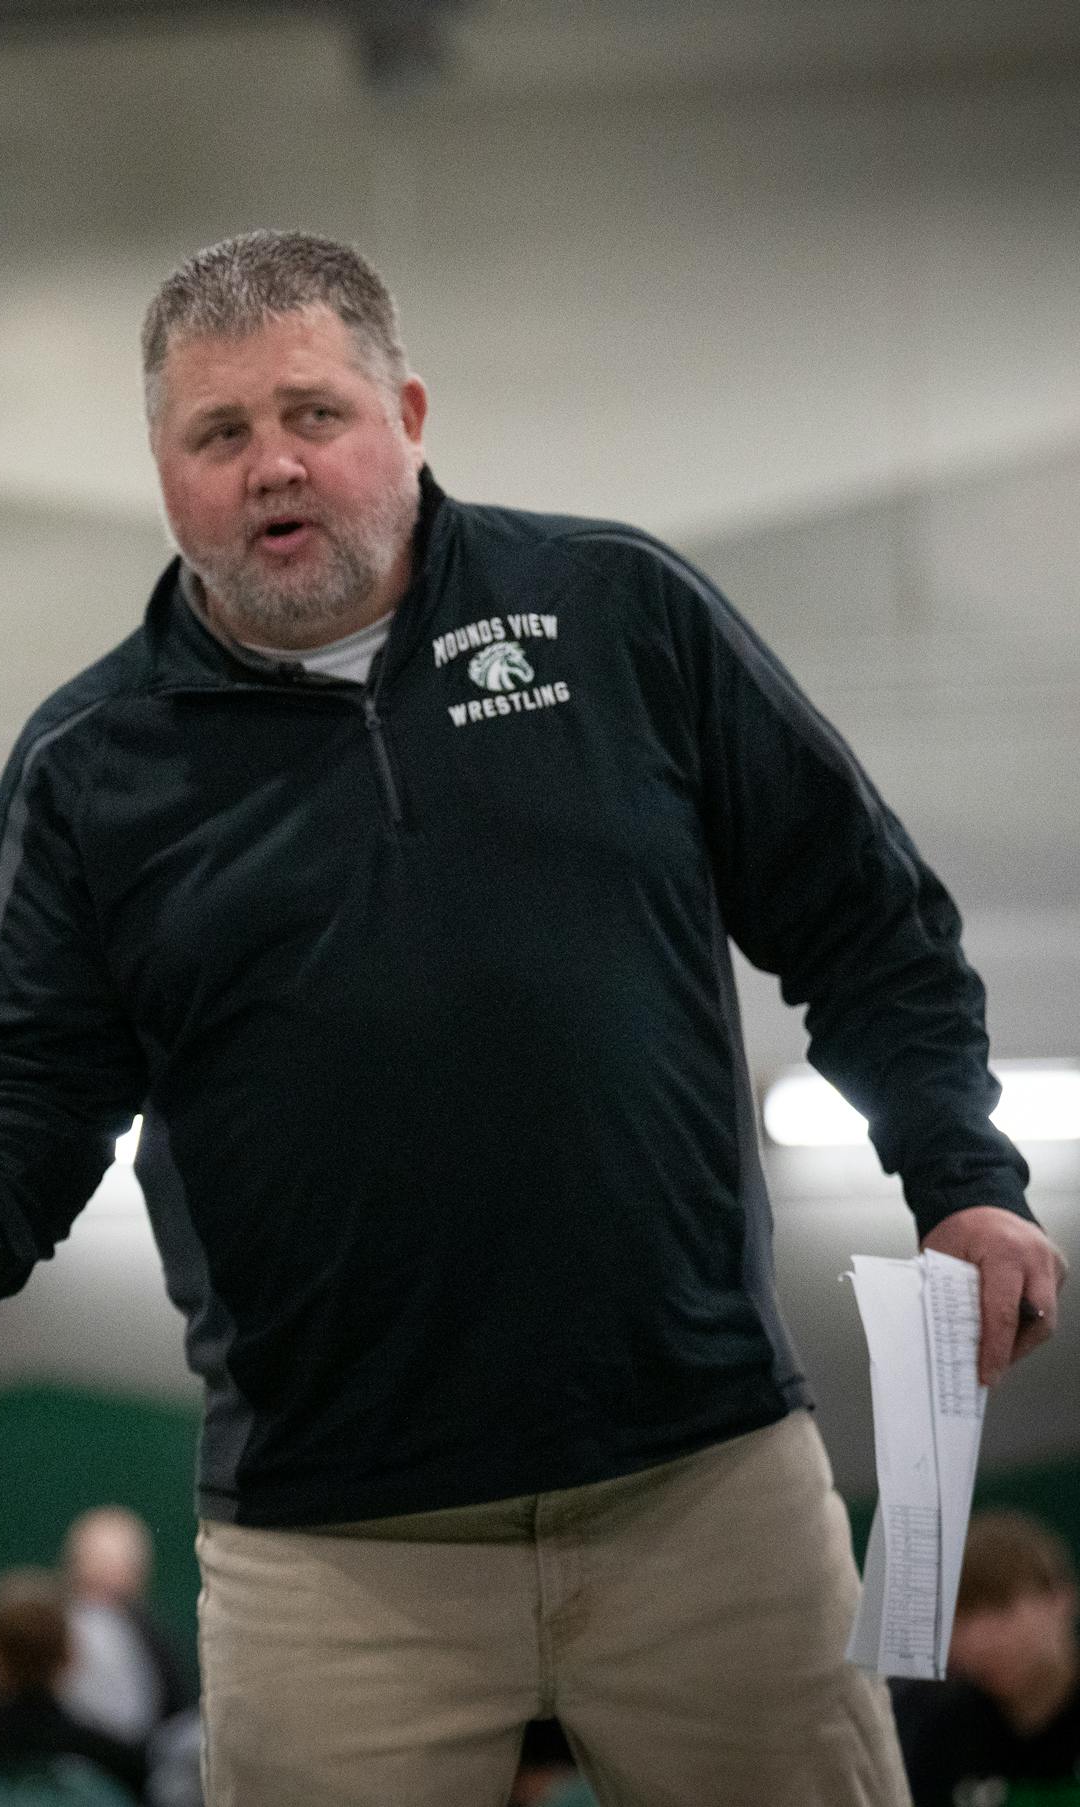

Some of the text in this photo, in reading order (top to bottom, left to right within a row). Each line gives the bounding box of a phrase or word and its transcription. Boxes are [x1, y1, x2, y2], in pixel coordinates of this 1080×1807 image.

[432, 612, 558, 668] MOUNDS VIEW
[448, 681, 571, 727] WRESTLING
